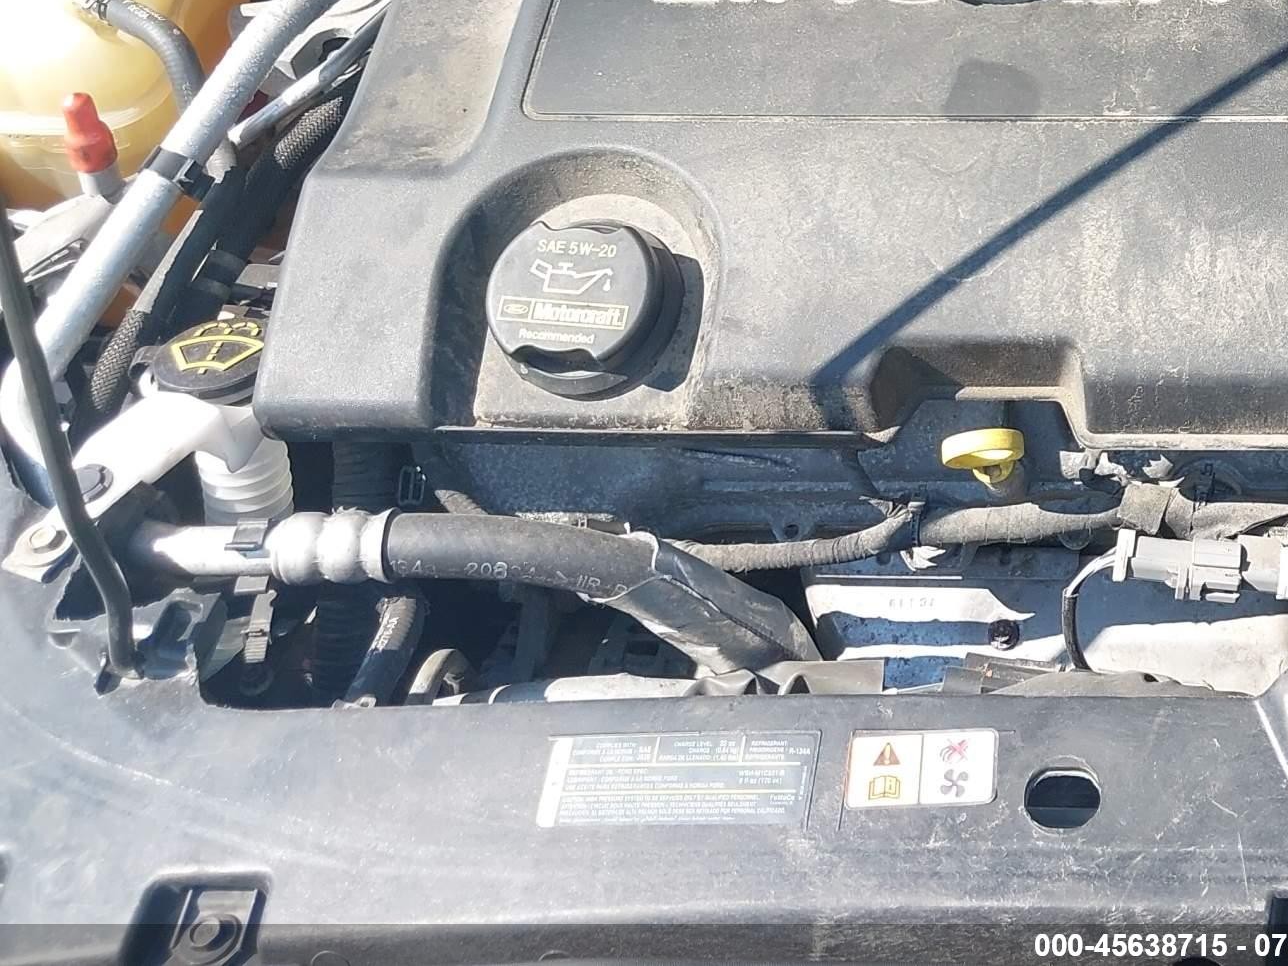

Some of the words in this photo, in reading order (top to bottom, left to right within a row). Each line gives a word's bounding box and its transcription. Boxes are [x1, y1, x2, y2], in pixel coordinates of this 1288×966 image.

[537, 239, 567, 254] SAE
[568, 241, 617, 258] 5W-20
[532, 302, 622, 325] Motorcraft
[518, 328, 595, 344] Recommended
